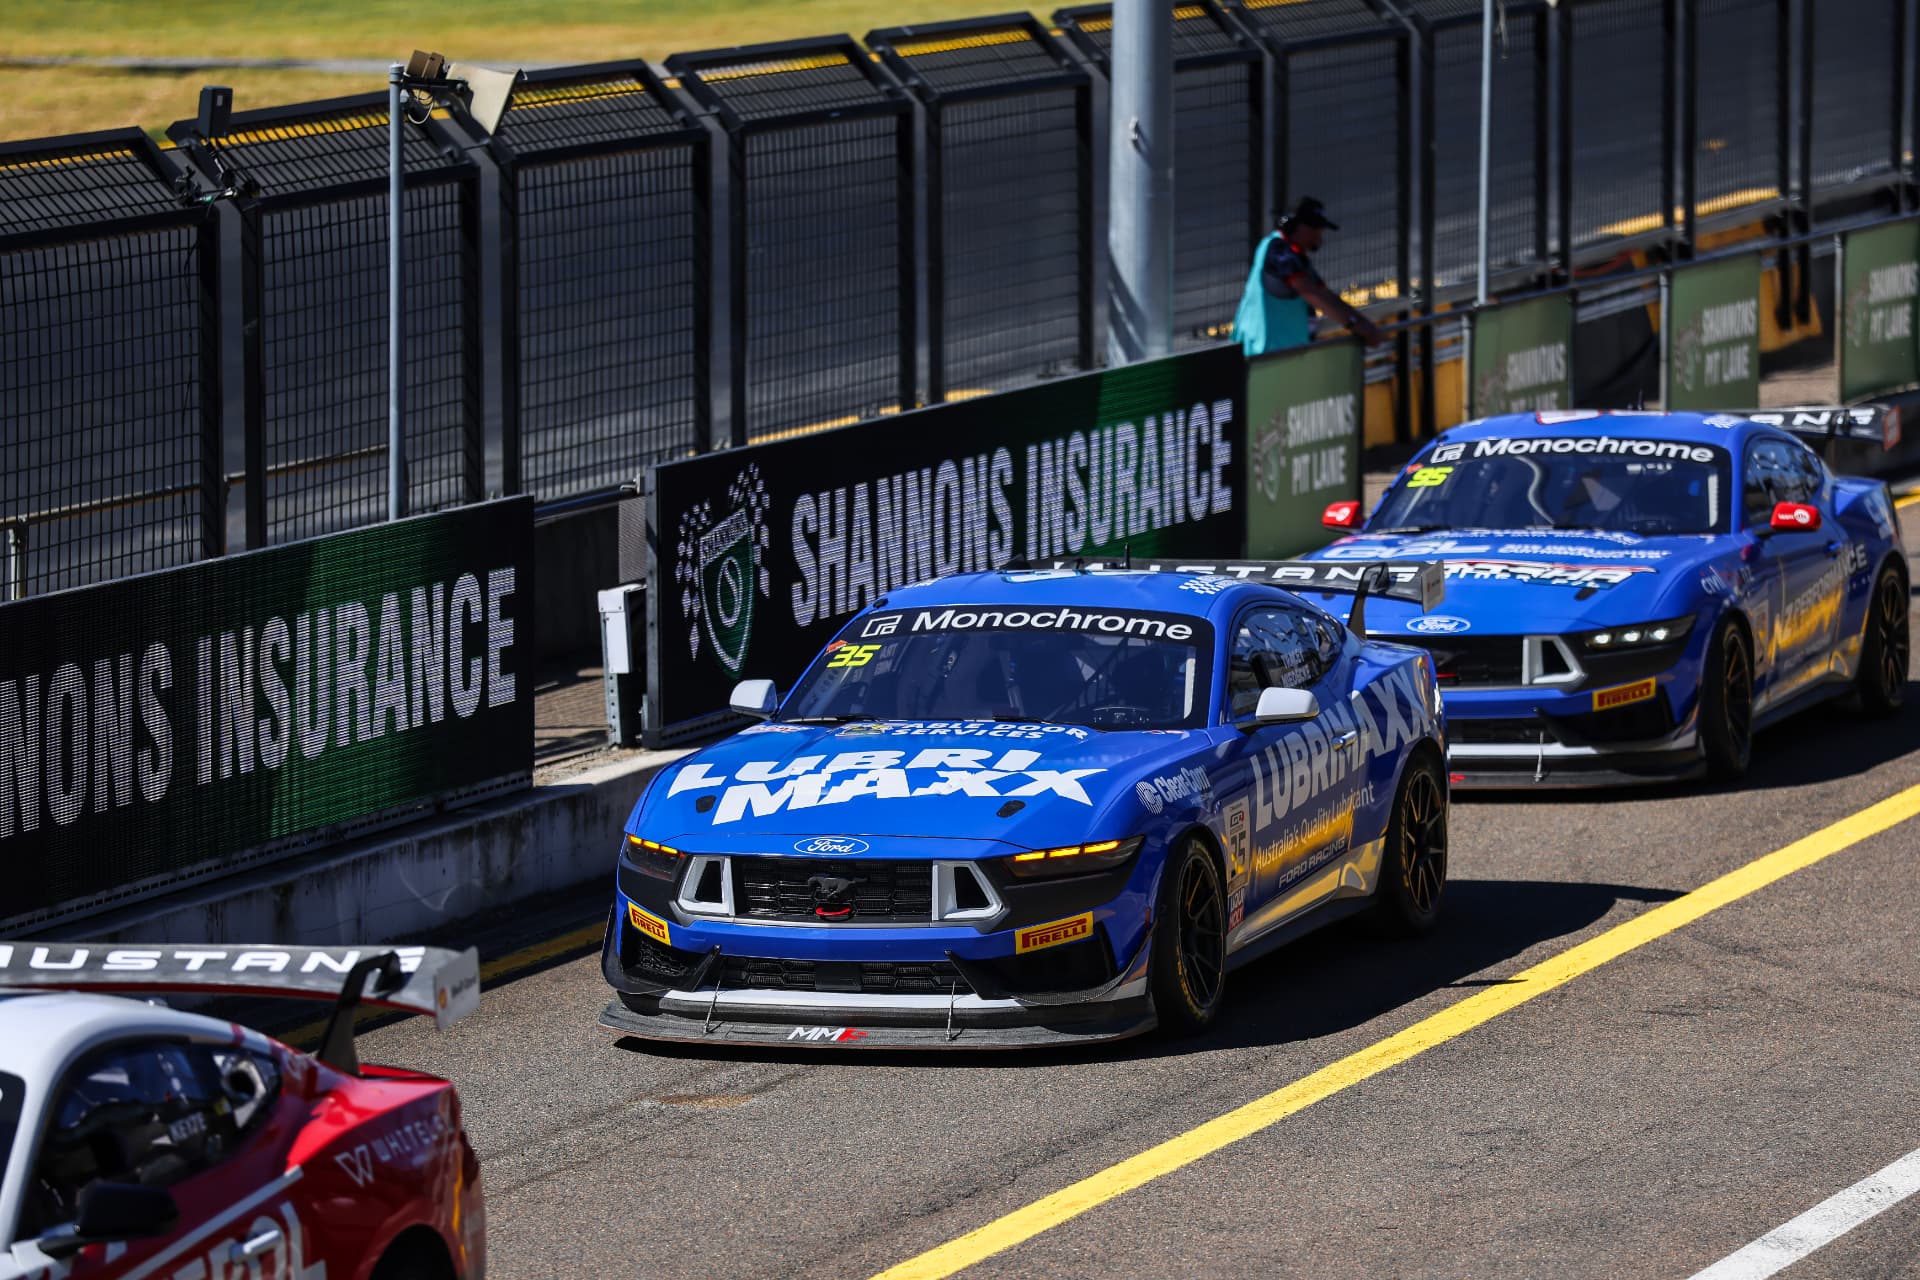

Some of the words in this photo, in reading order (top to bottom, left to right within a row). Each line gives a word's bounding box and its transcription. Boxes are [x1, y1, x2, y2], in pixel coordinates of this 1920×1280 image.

[1702, 298, 1757, 346] SHANNONS
[1722, 343, 1749, 382] LANE
[1287, 393, 1355, 448] SHANNONS
[1292, 453, 1310, 496] PIT
[1313, 445, 1346, 490] LANE
[1473, 436, 1715, 463] Monochrome
[791, 447, 1014, 627] SHANNONS
[1025, 398, 1234, 560] INSURANCE
[911, 608, 1193, 641] Monochrome
[1416, 617, 1461, 631] Ford
[197, 567, 516, 785] INSURANCE
[827, 645, 881, 668] 35
[891, 728, 1045, 739] SERVICES
[901, 722, 985, 730] ABLE
[1000, 722, 1089, 740] DOOR
[1250, 667, 1431, 832] LUBRIMAXX
[667, 748, 1042, 798] LUBRI
[712, 767, 1108, 825] MAXX
[803, 837, 859, 854] Ford
[1255, 826, 1299, 872] Australia's
[1301, 803, 1330, 844] Quality
[1279, 862, 1308, 888] FORD
[1308, 836, 1346, 869] RACING
[632, 908, 666, 939] PIRELLI
[1022, 918, 1087, 949] PIRELLI
